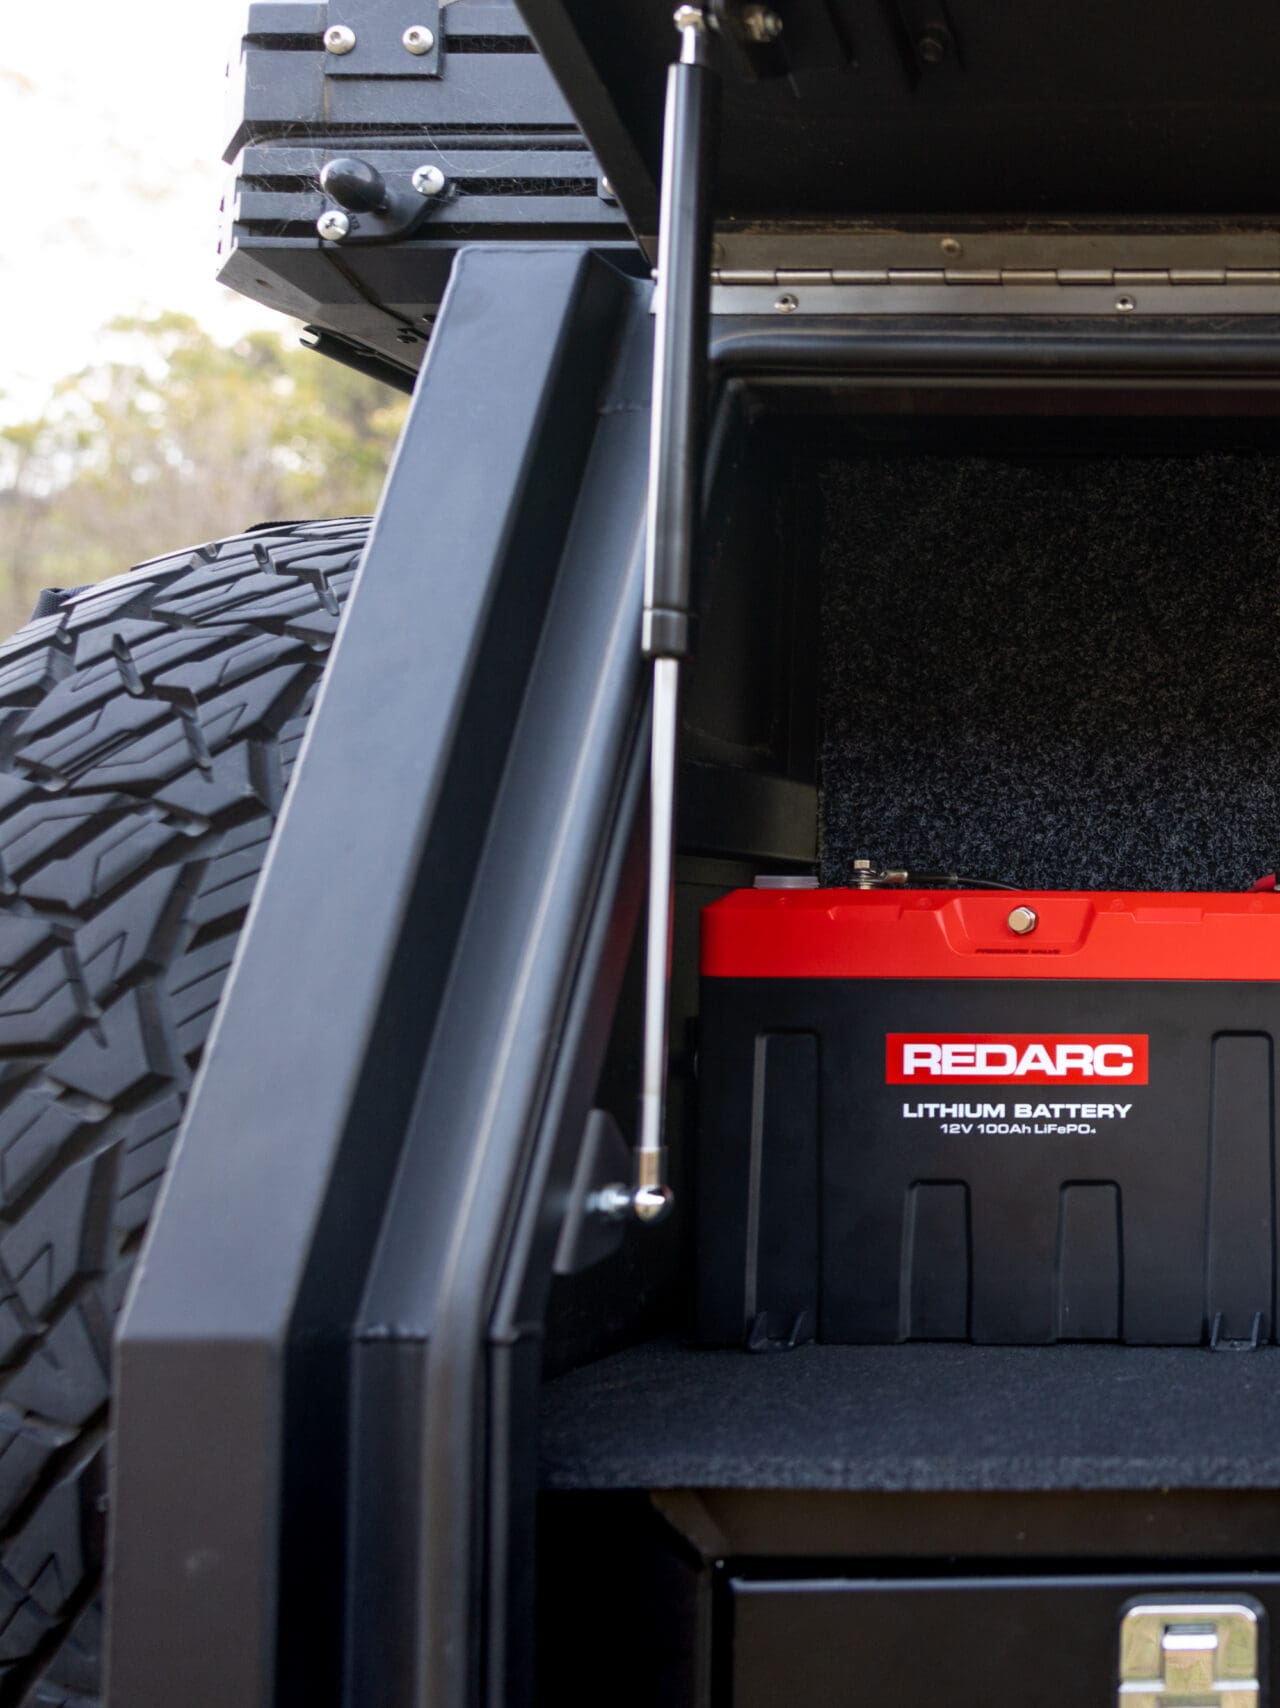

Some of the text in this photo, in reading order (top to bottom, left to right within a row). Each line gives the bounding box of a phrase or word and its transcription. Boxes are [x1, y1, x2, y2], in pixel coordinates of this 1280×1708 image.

[903, 1042, 1134, 1077] REDARC
[902, 1103, 1133, 1119] LITHIUM BATTERY
[939, 1123, 974, 1135] 12V
[977, 1123, 1032, 1135] 100Ah
